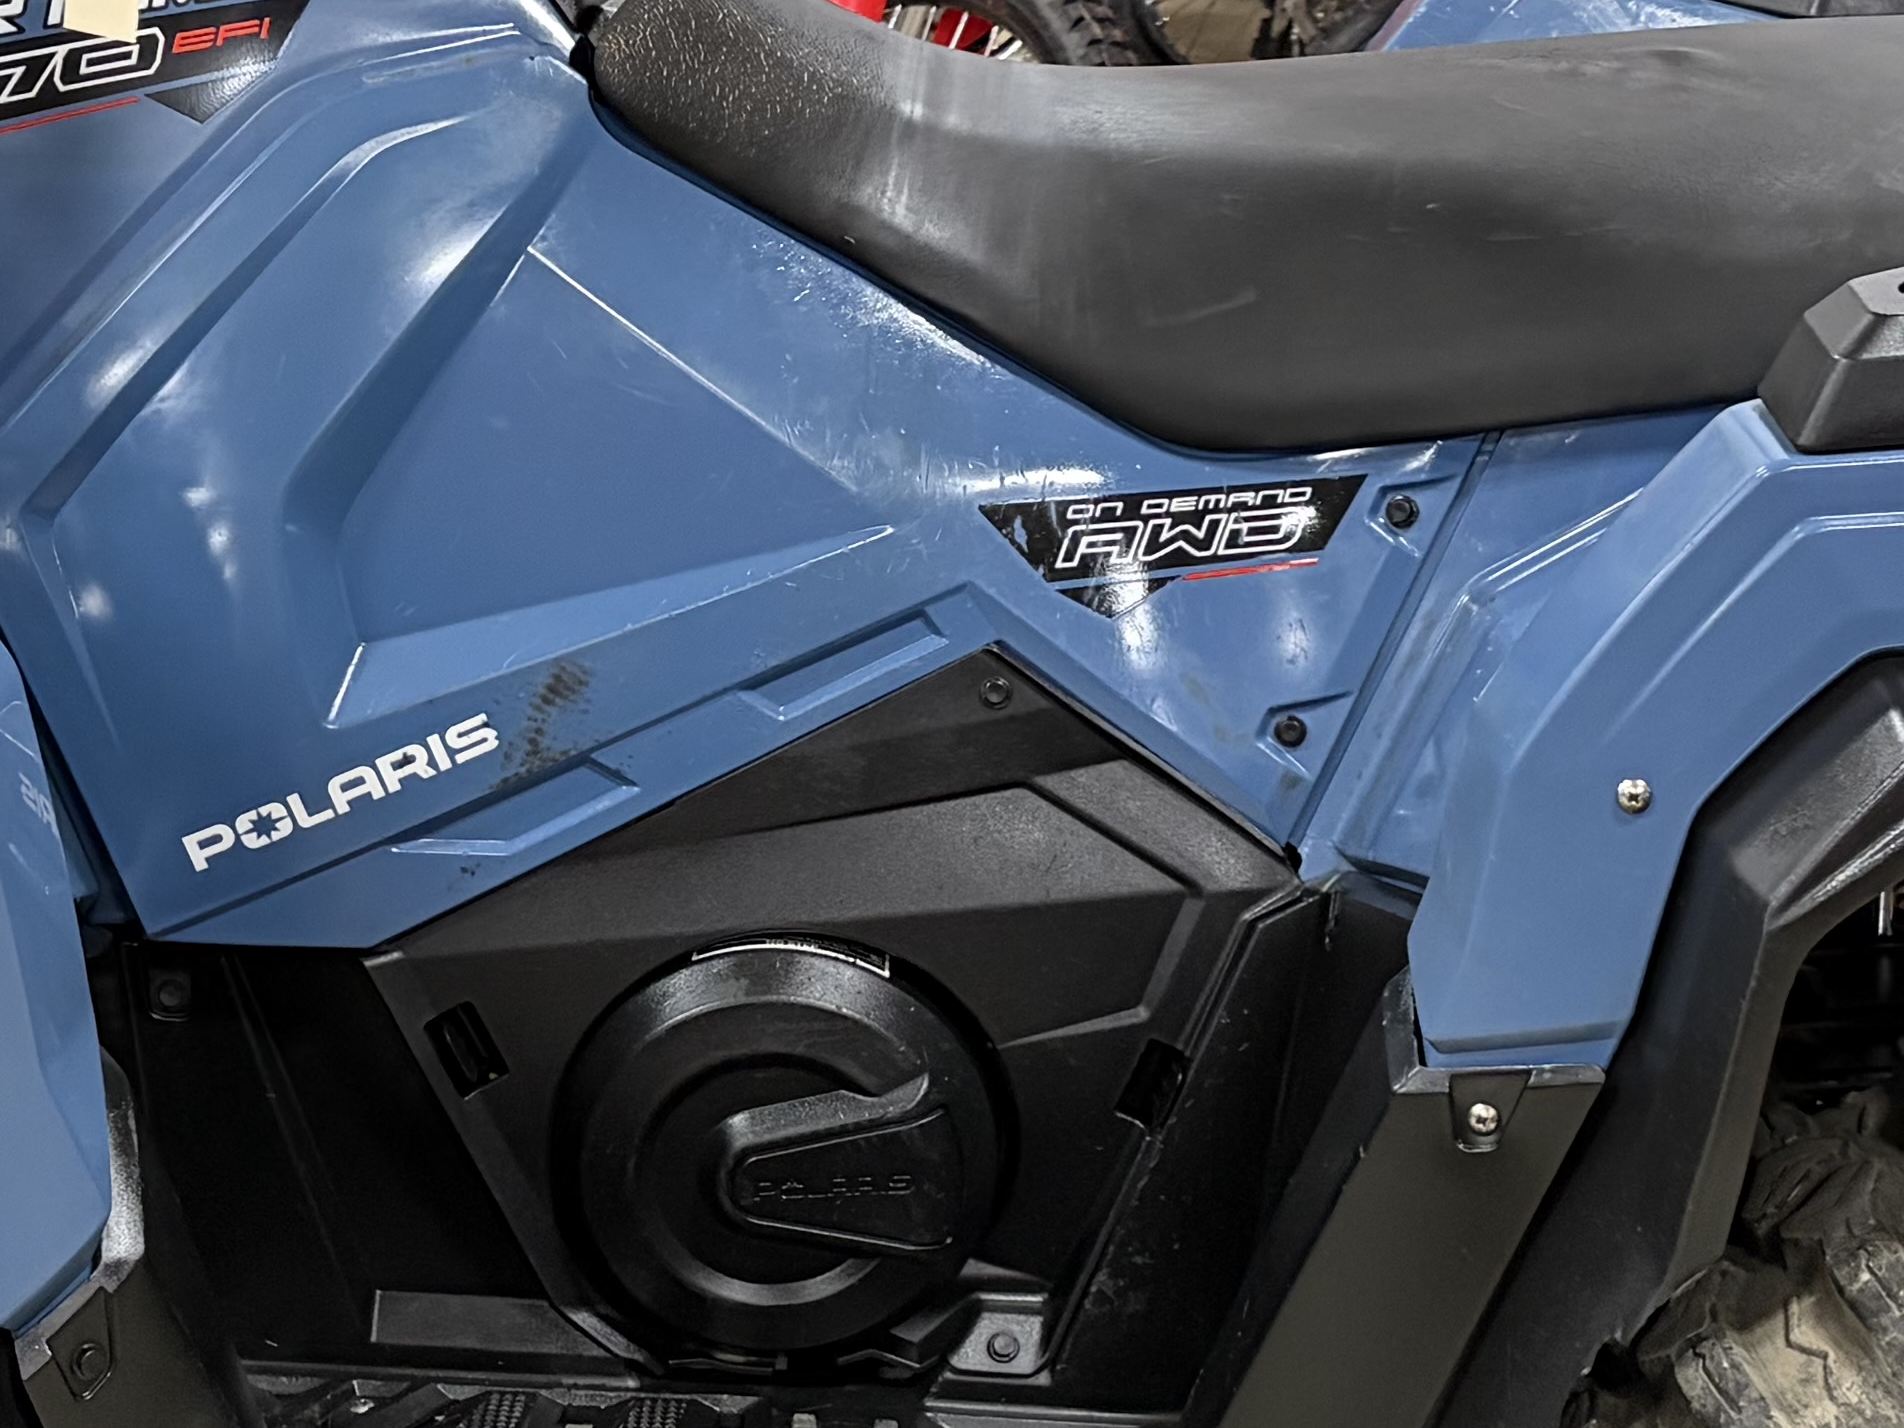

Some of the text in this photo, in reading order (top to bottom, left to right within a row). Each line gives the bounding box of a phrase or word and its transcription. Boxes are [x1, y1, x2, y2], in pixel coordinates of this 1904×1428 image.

[171, 17, 271, 54] EFI
[1065, 486, 1313, 520] ON DEMAND
[1054, 506, 1309, 569] AWD
[181, 712, 500, 873] POLARIS
[751, 1174, 915, 1204] POLARIS
